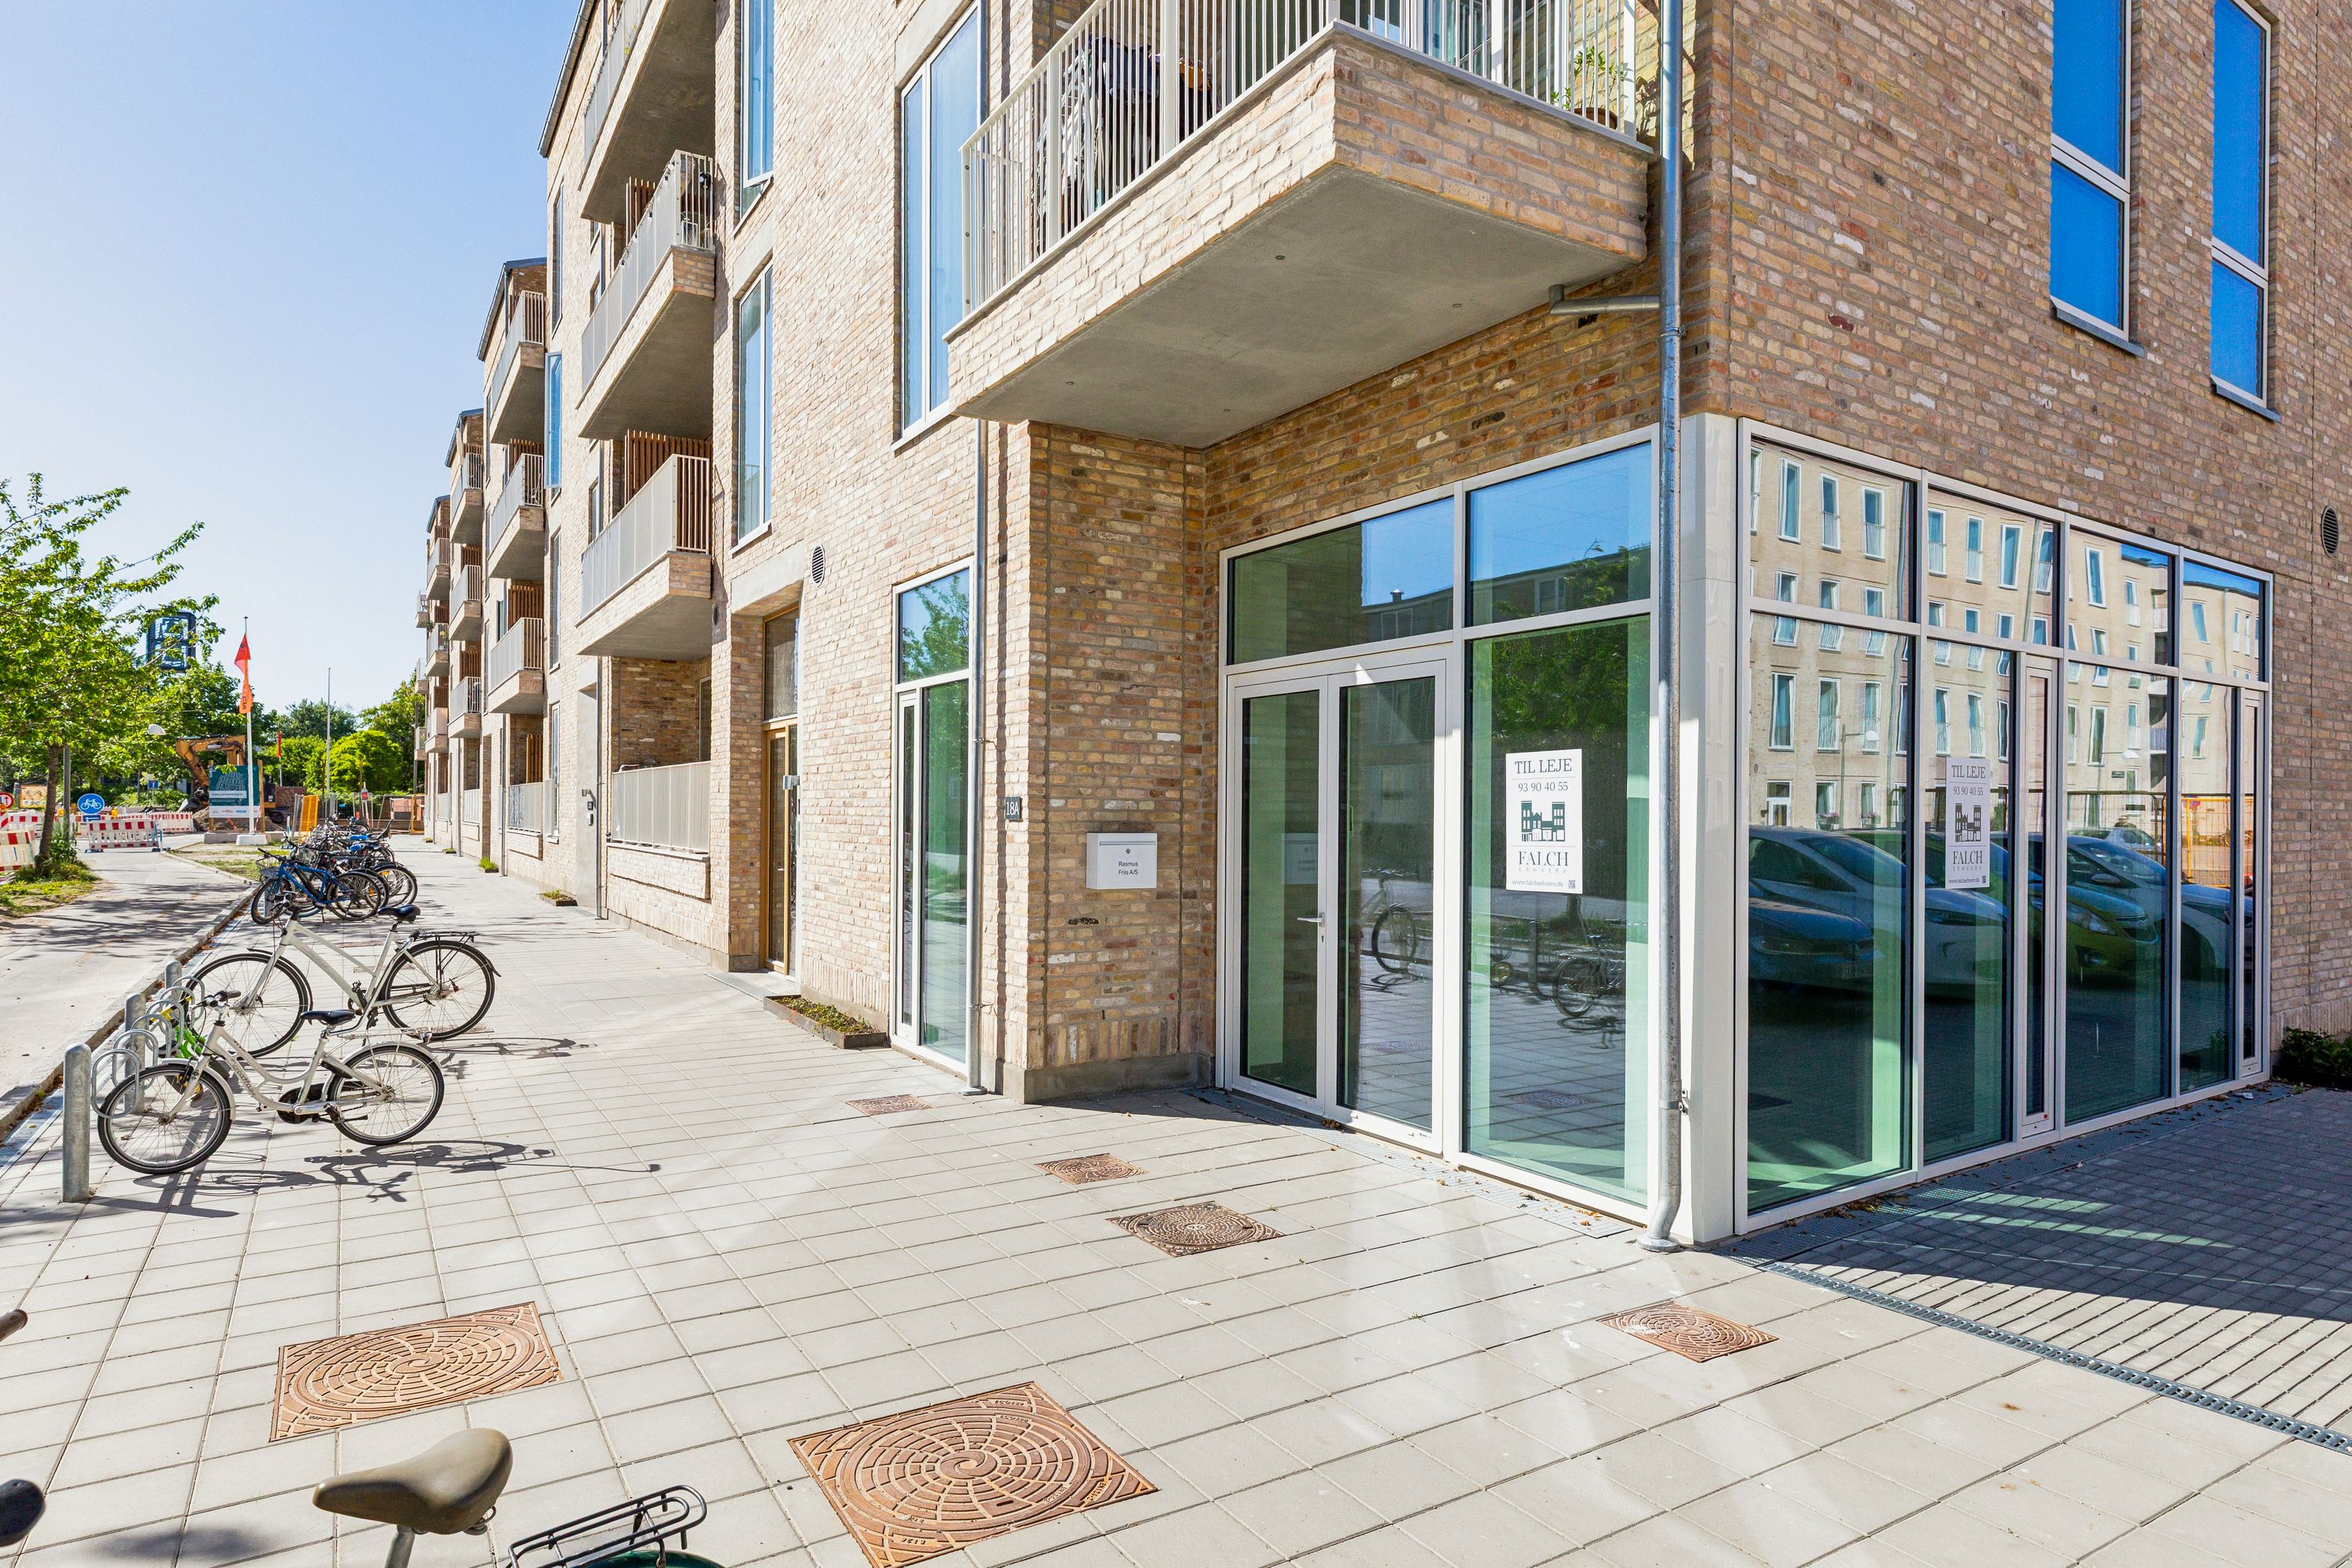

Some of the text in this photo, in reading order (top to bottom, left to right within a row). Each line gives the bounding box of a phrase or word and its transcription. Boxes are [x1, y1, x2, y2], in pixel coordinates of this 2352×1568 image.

[1514, 758, 1572, 774] TIL LEJE
[1951, 764, 1986, 779] TIL LEJE
[1518, 781, 1569, 793] 93 90 40 55
[1953, 786, 1984, 796] 93 90 40 55
[1006, 800, 1020, 815] 18A
[1518, 851, 1569, 866] FALCH
[1952, 851, 1983, 865] FALCH
